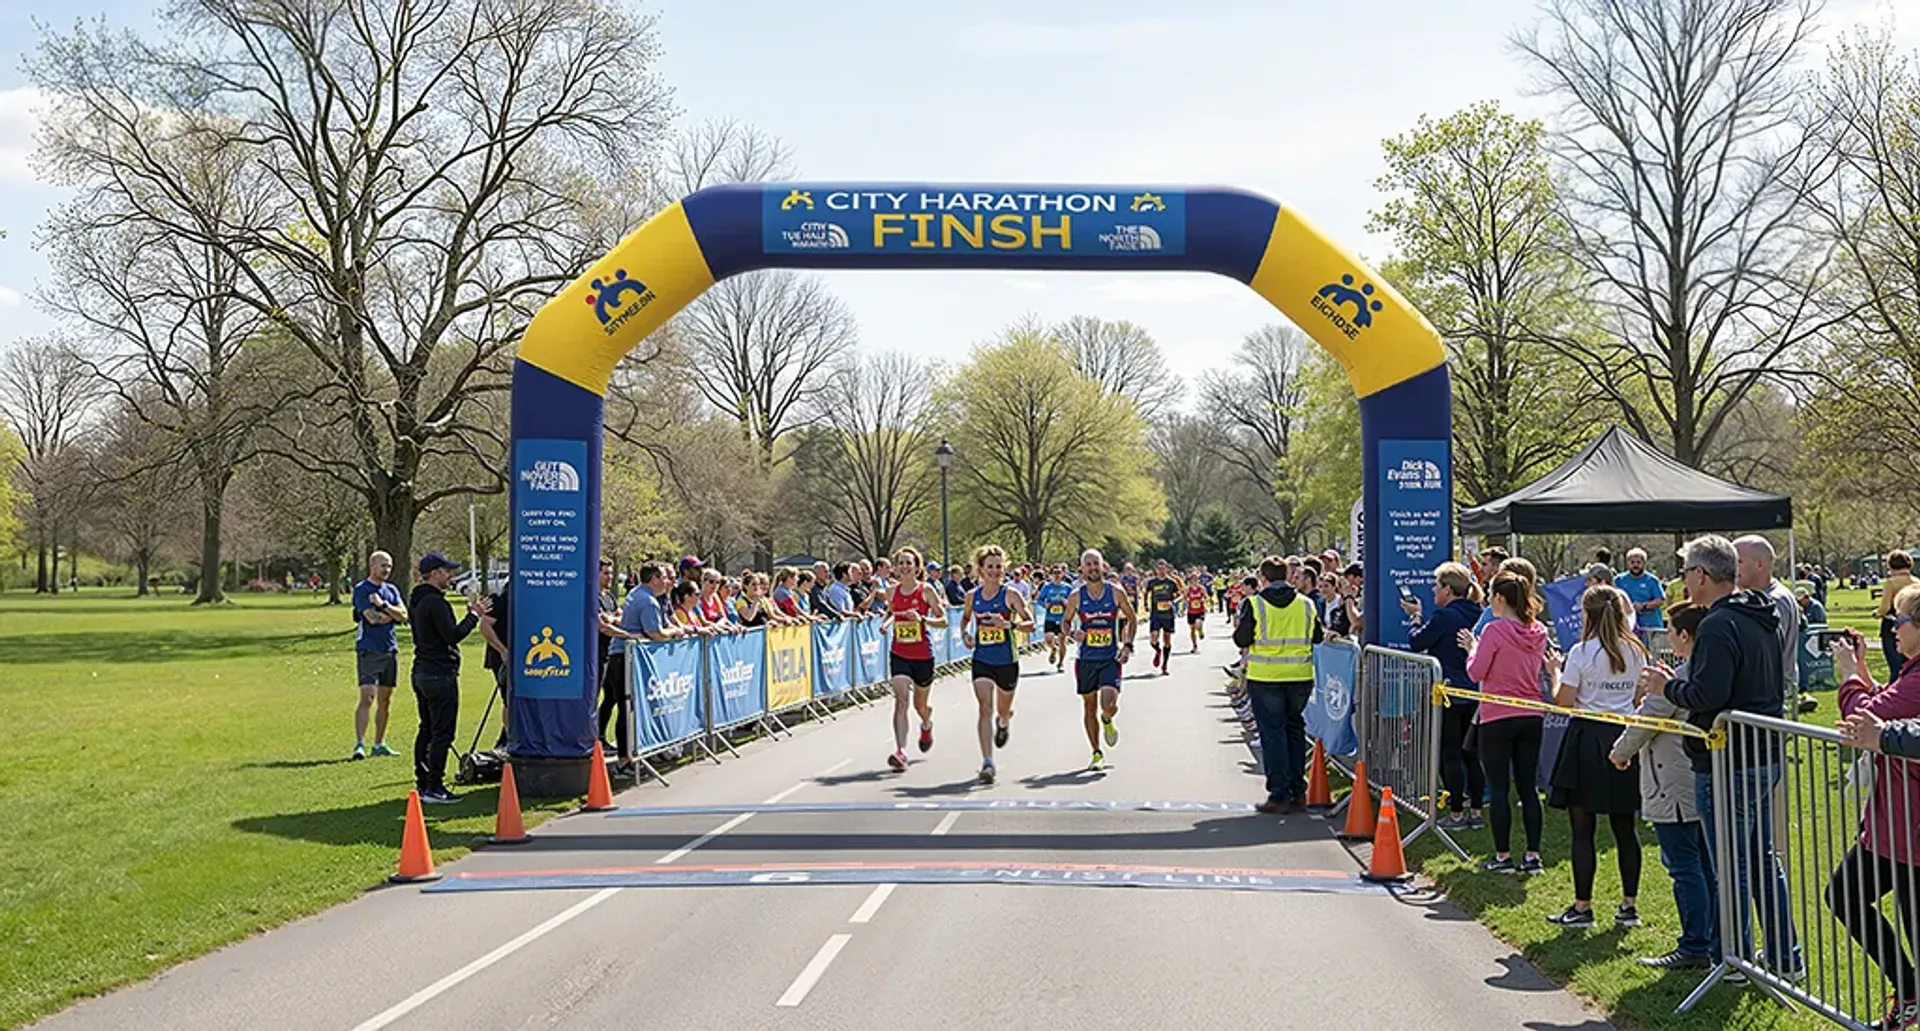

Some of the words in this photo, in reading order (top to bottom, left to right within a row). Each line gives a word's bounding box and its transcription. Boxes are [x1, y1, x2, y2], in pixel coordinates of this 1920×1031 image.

[826, 191, 908, 210] CITY
[920, 192, 1117, 213] HARATHON
[873, 212, 1072, 250] FINSH
[1114, 225, 1138, 235] THE
[1098, 233, 1138, 243] NORTH
[1402, 459, 1425, 470] Dick
[1387, 469, 1421, 480] Evans
